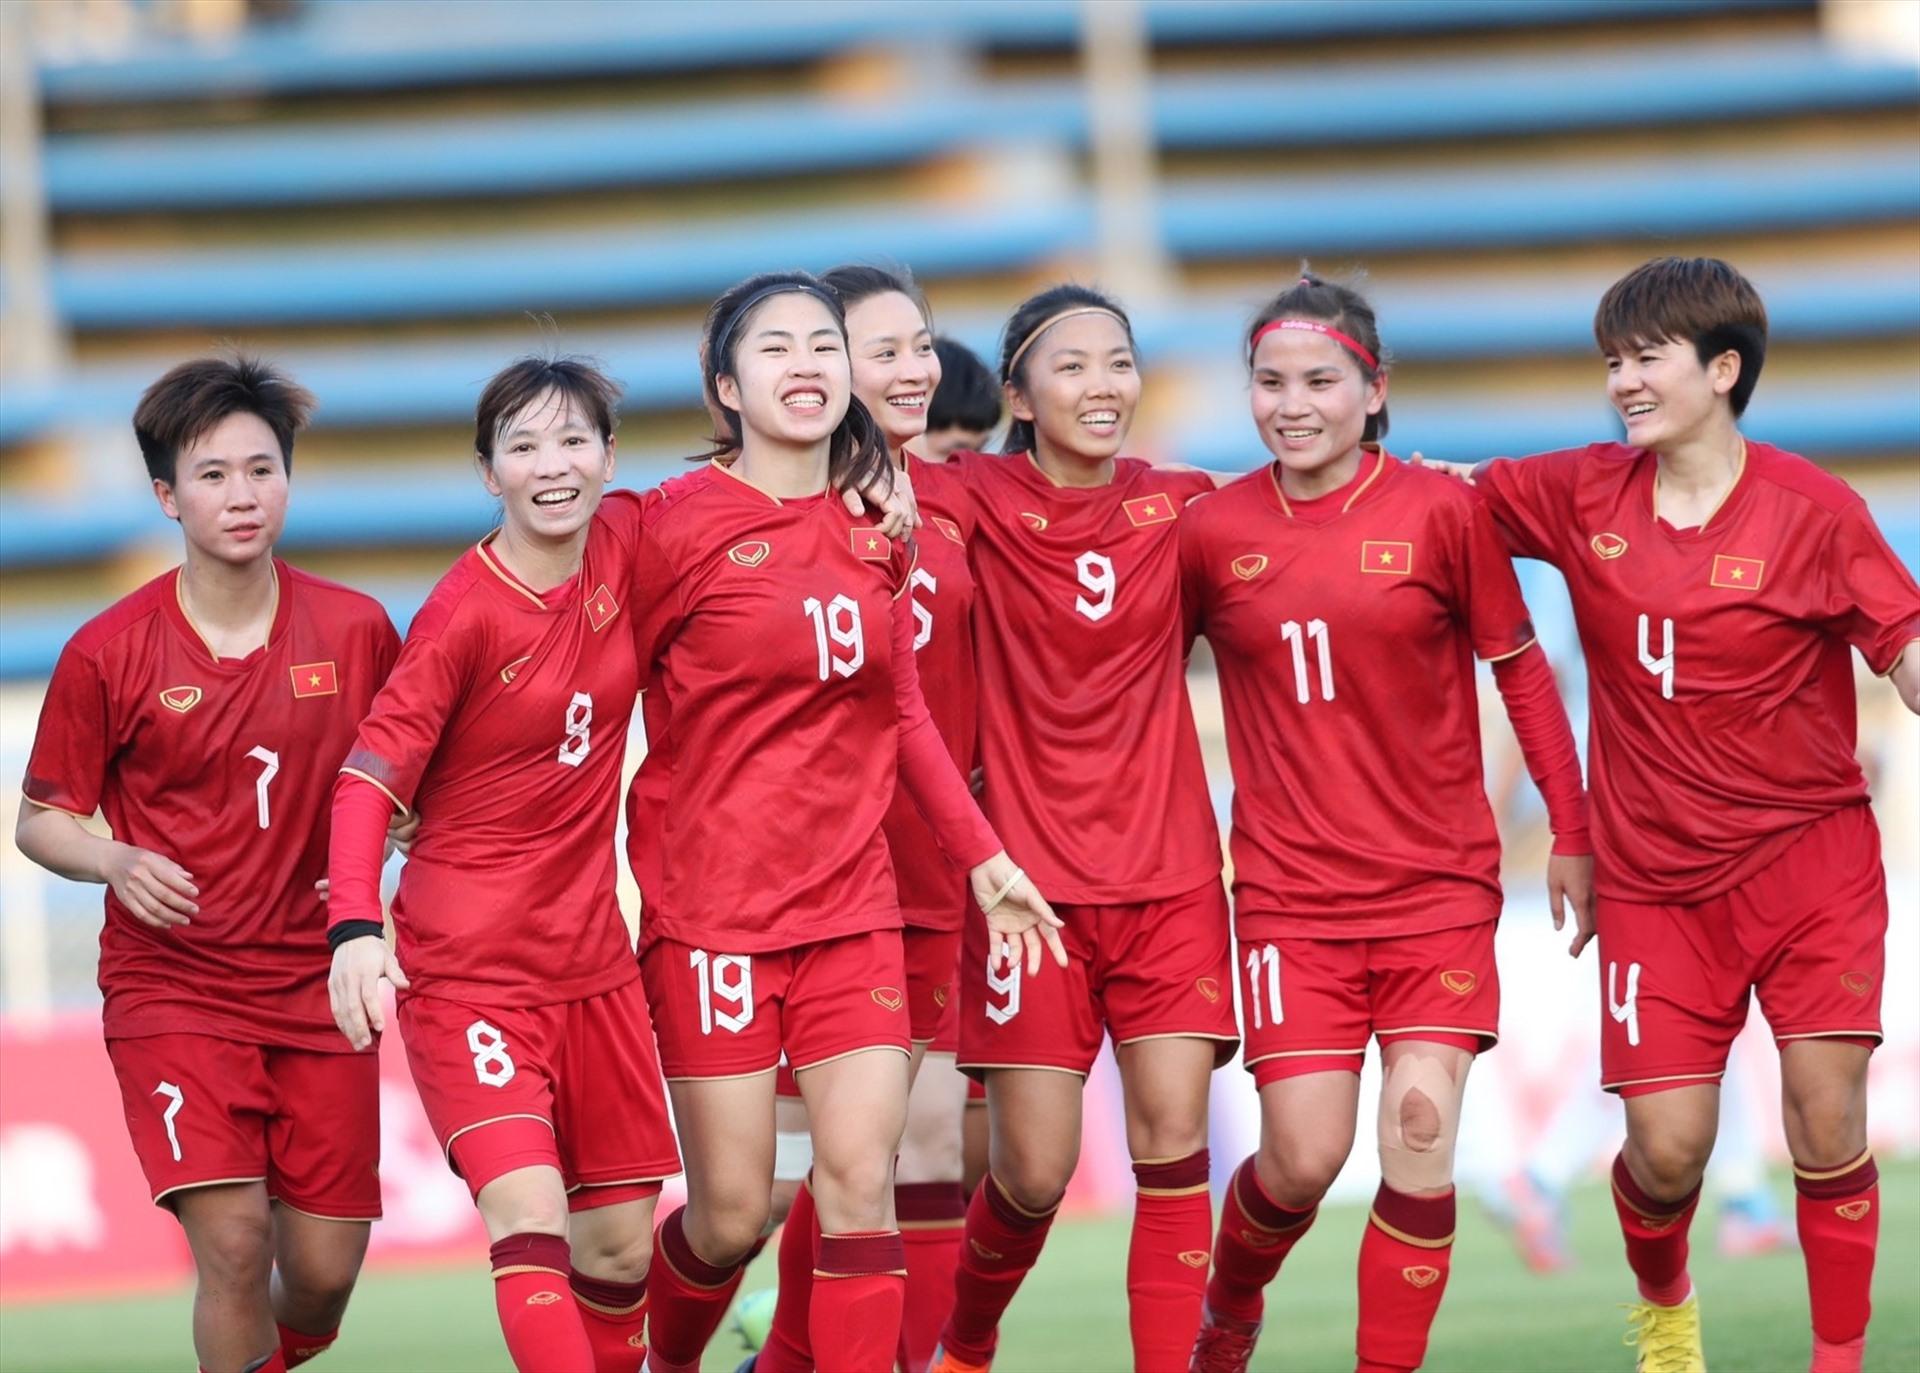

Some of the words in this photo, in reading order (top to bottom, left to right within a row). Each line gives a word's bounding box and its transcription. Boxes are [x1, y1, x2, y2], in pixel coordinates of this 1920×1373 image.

[1075, 551, 1117, 622] 9
[802, 592, 865, 682] 19
[1280, 618, 1335, 705] 11
[1637, 613, 1675, 700] 4
[557, 692, 593, 768] 8
[245, 745, 280, 830] 7
[689, 948, 754, 1036] 19
[986, 942, 1022, 1025] 9
[1246, 944, 1284, 1029] 11
[1608, 962, 1641, 1046] 4
[466, 1019, 516, 1089] 8
[152, 1080, 184, 1162] 7
